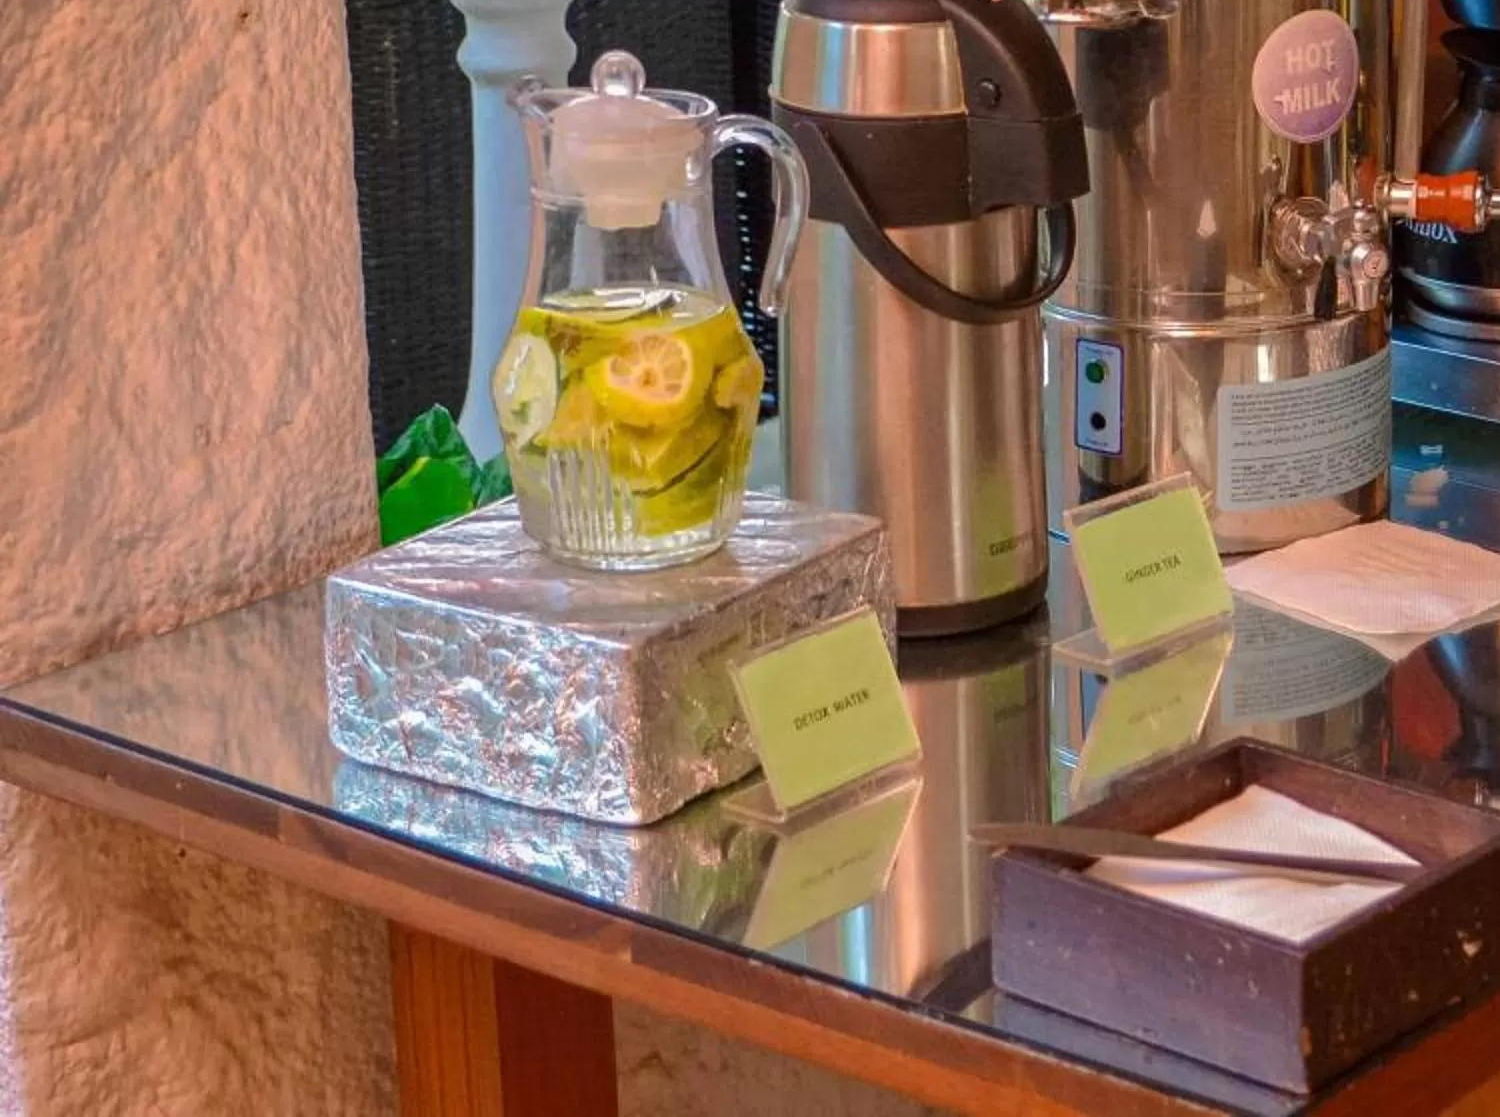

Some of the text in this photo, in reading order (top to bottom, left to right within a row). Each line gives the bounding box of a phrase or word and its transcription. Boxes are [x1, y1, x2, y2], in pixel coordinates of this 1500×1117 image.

[1286, 38, 1336, 76] HOT
[1276, 77, 1341, 115] MILK
[1124, 553, 1182, 584] GINGER TEA
[794, 687, 870, 732] DETOX WATER
